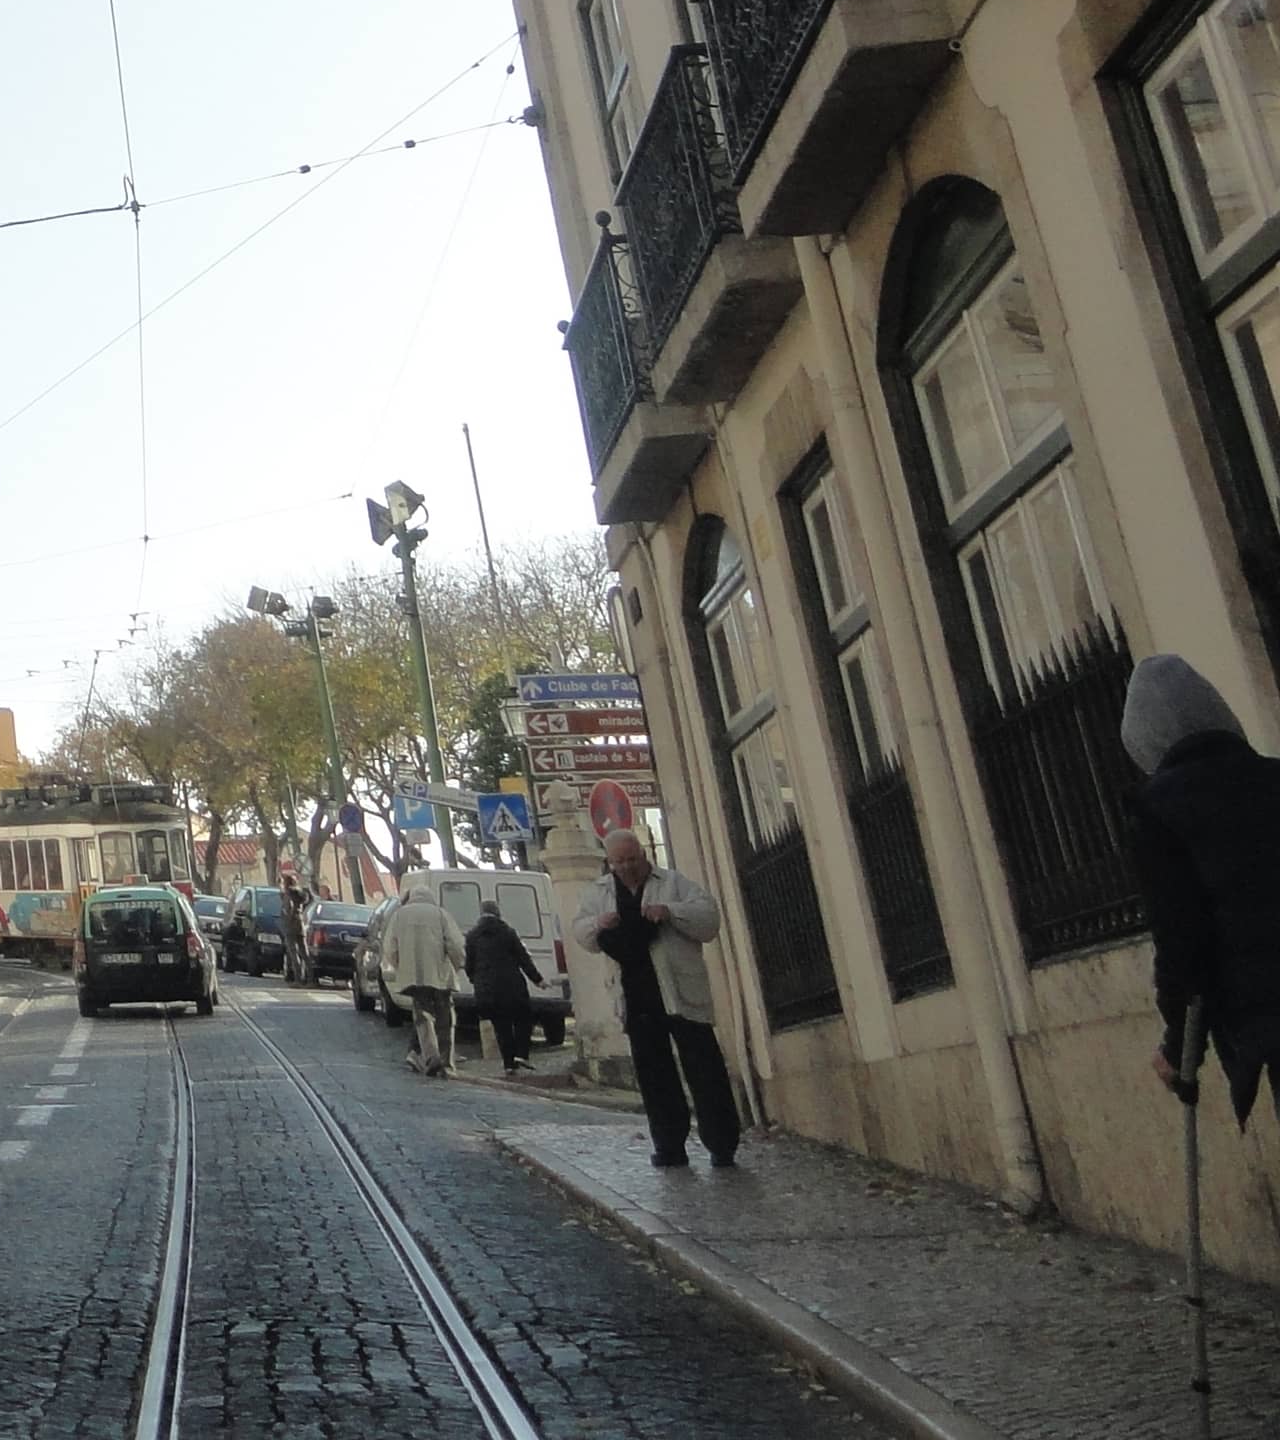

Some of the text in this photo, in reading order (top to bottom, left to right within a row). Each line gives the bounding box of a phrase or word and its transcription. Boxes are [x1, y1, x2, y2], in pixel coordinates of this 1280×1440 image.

[548, 679, 639, 692] Clube de Fad
